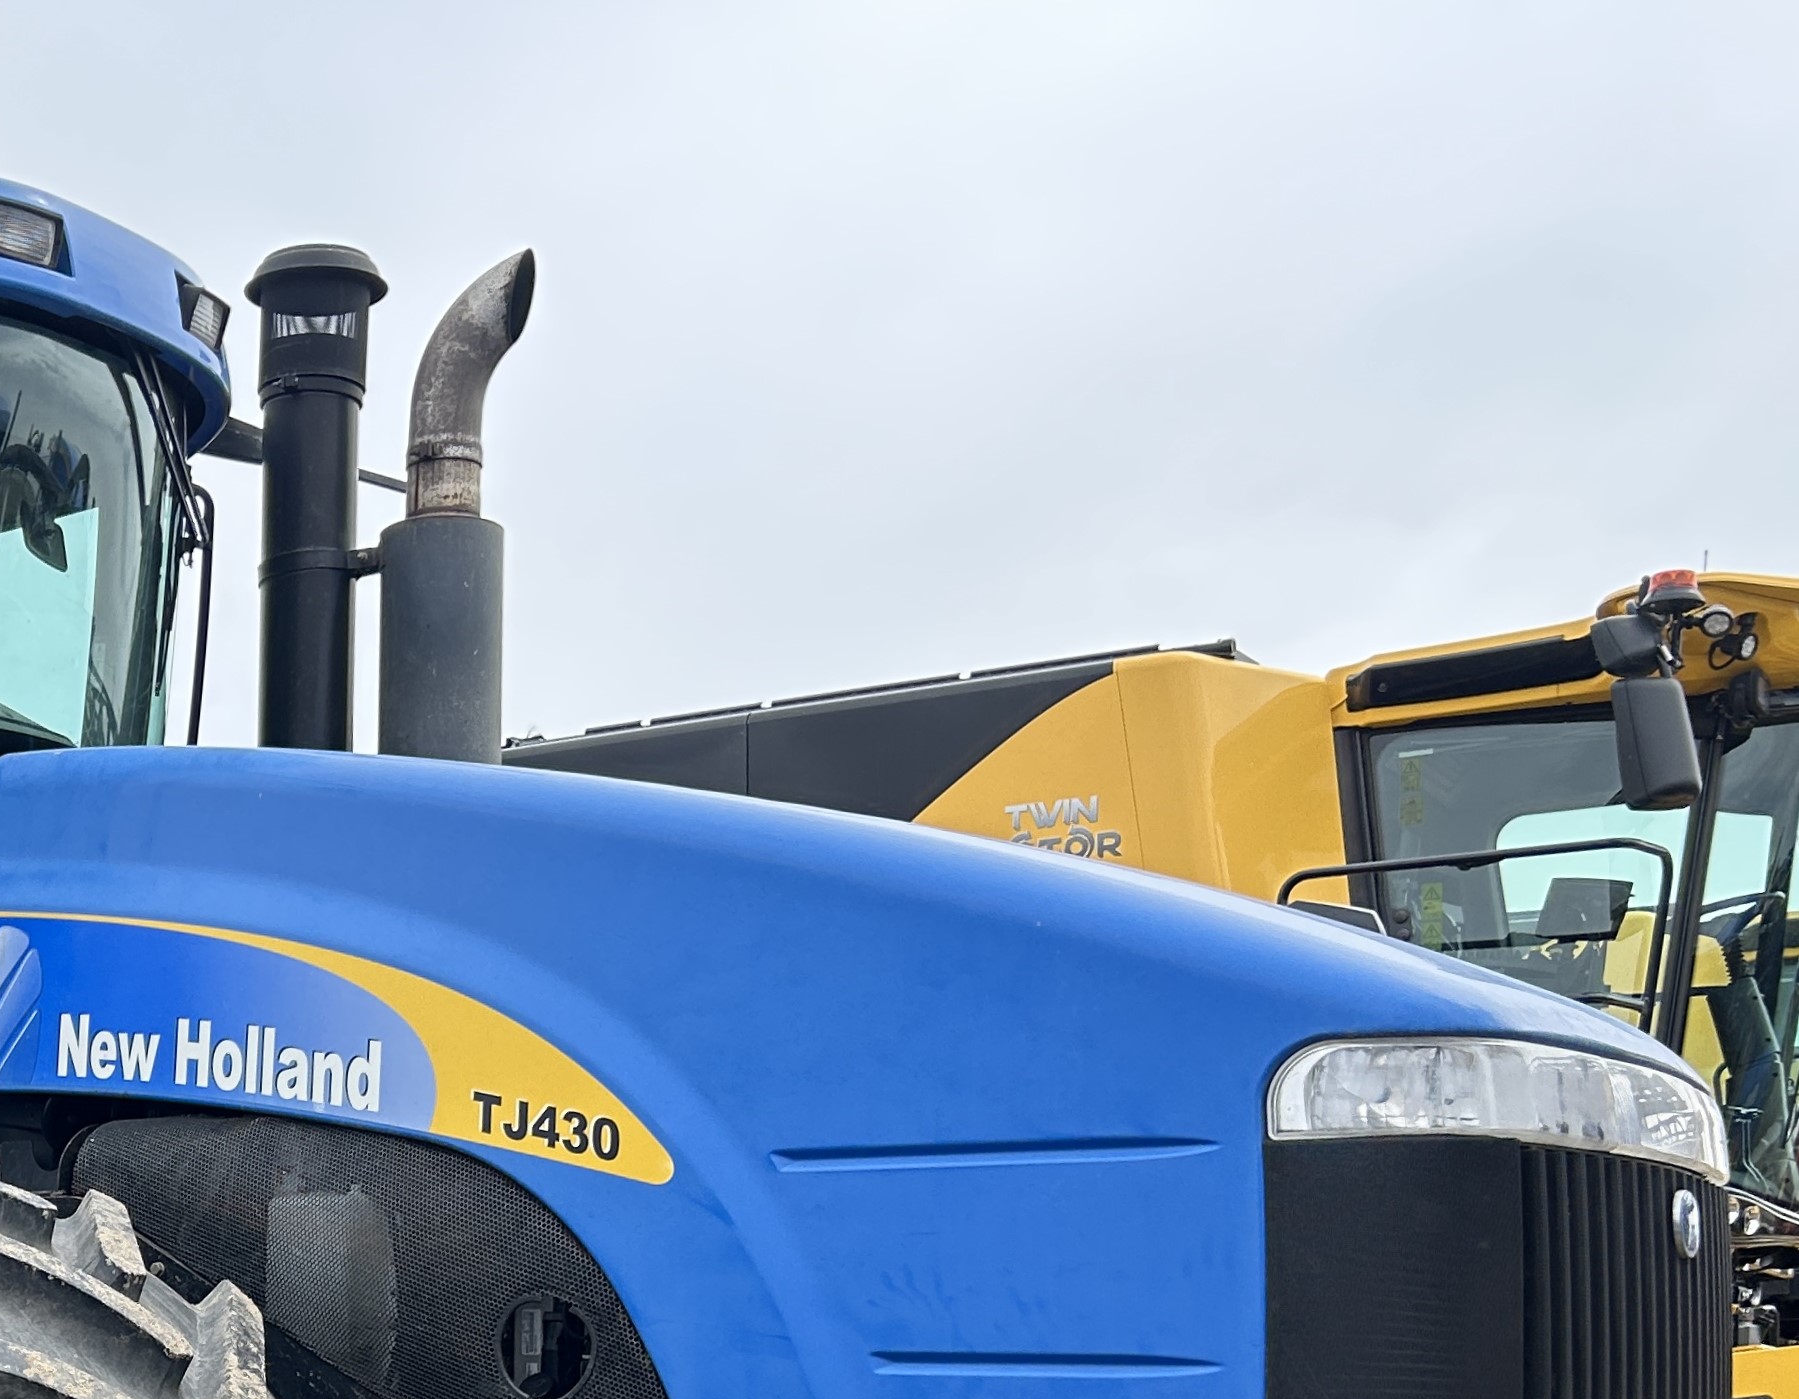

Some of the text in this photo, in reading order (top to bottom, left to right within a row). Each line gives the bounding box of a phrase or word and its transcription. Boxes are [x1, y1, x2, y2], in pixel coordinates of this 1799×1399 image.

[1004, 794, 1099, 831] TWIN
[57, 1012, 383, 1113] New Holland
[472, 1090, 621, 1162] TJ430
